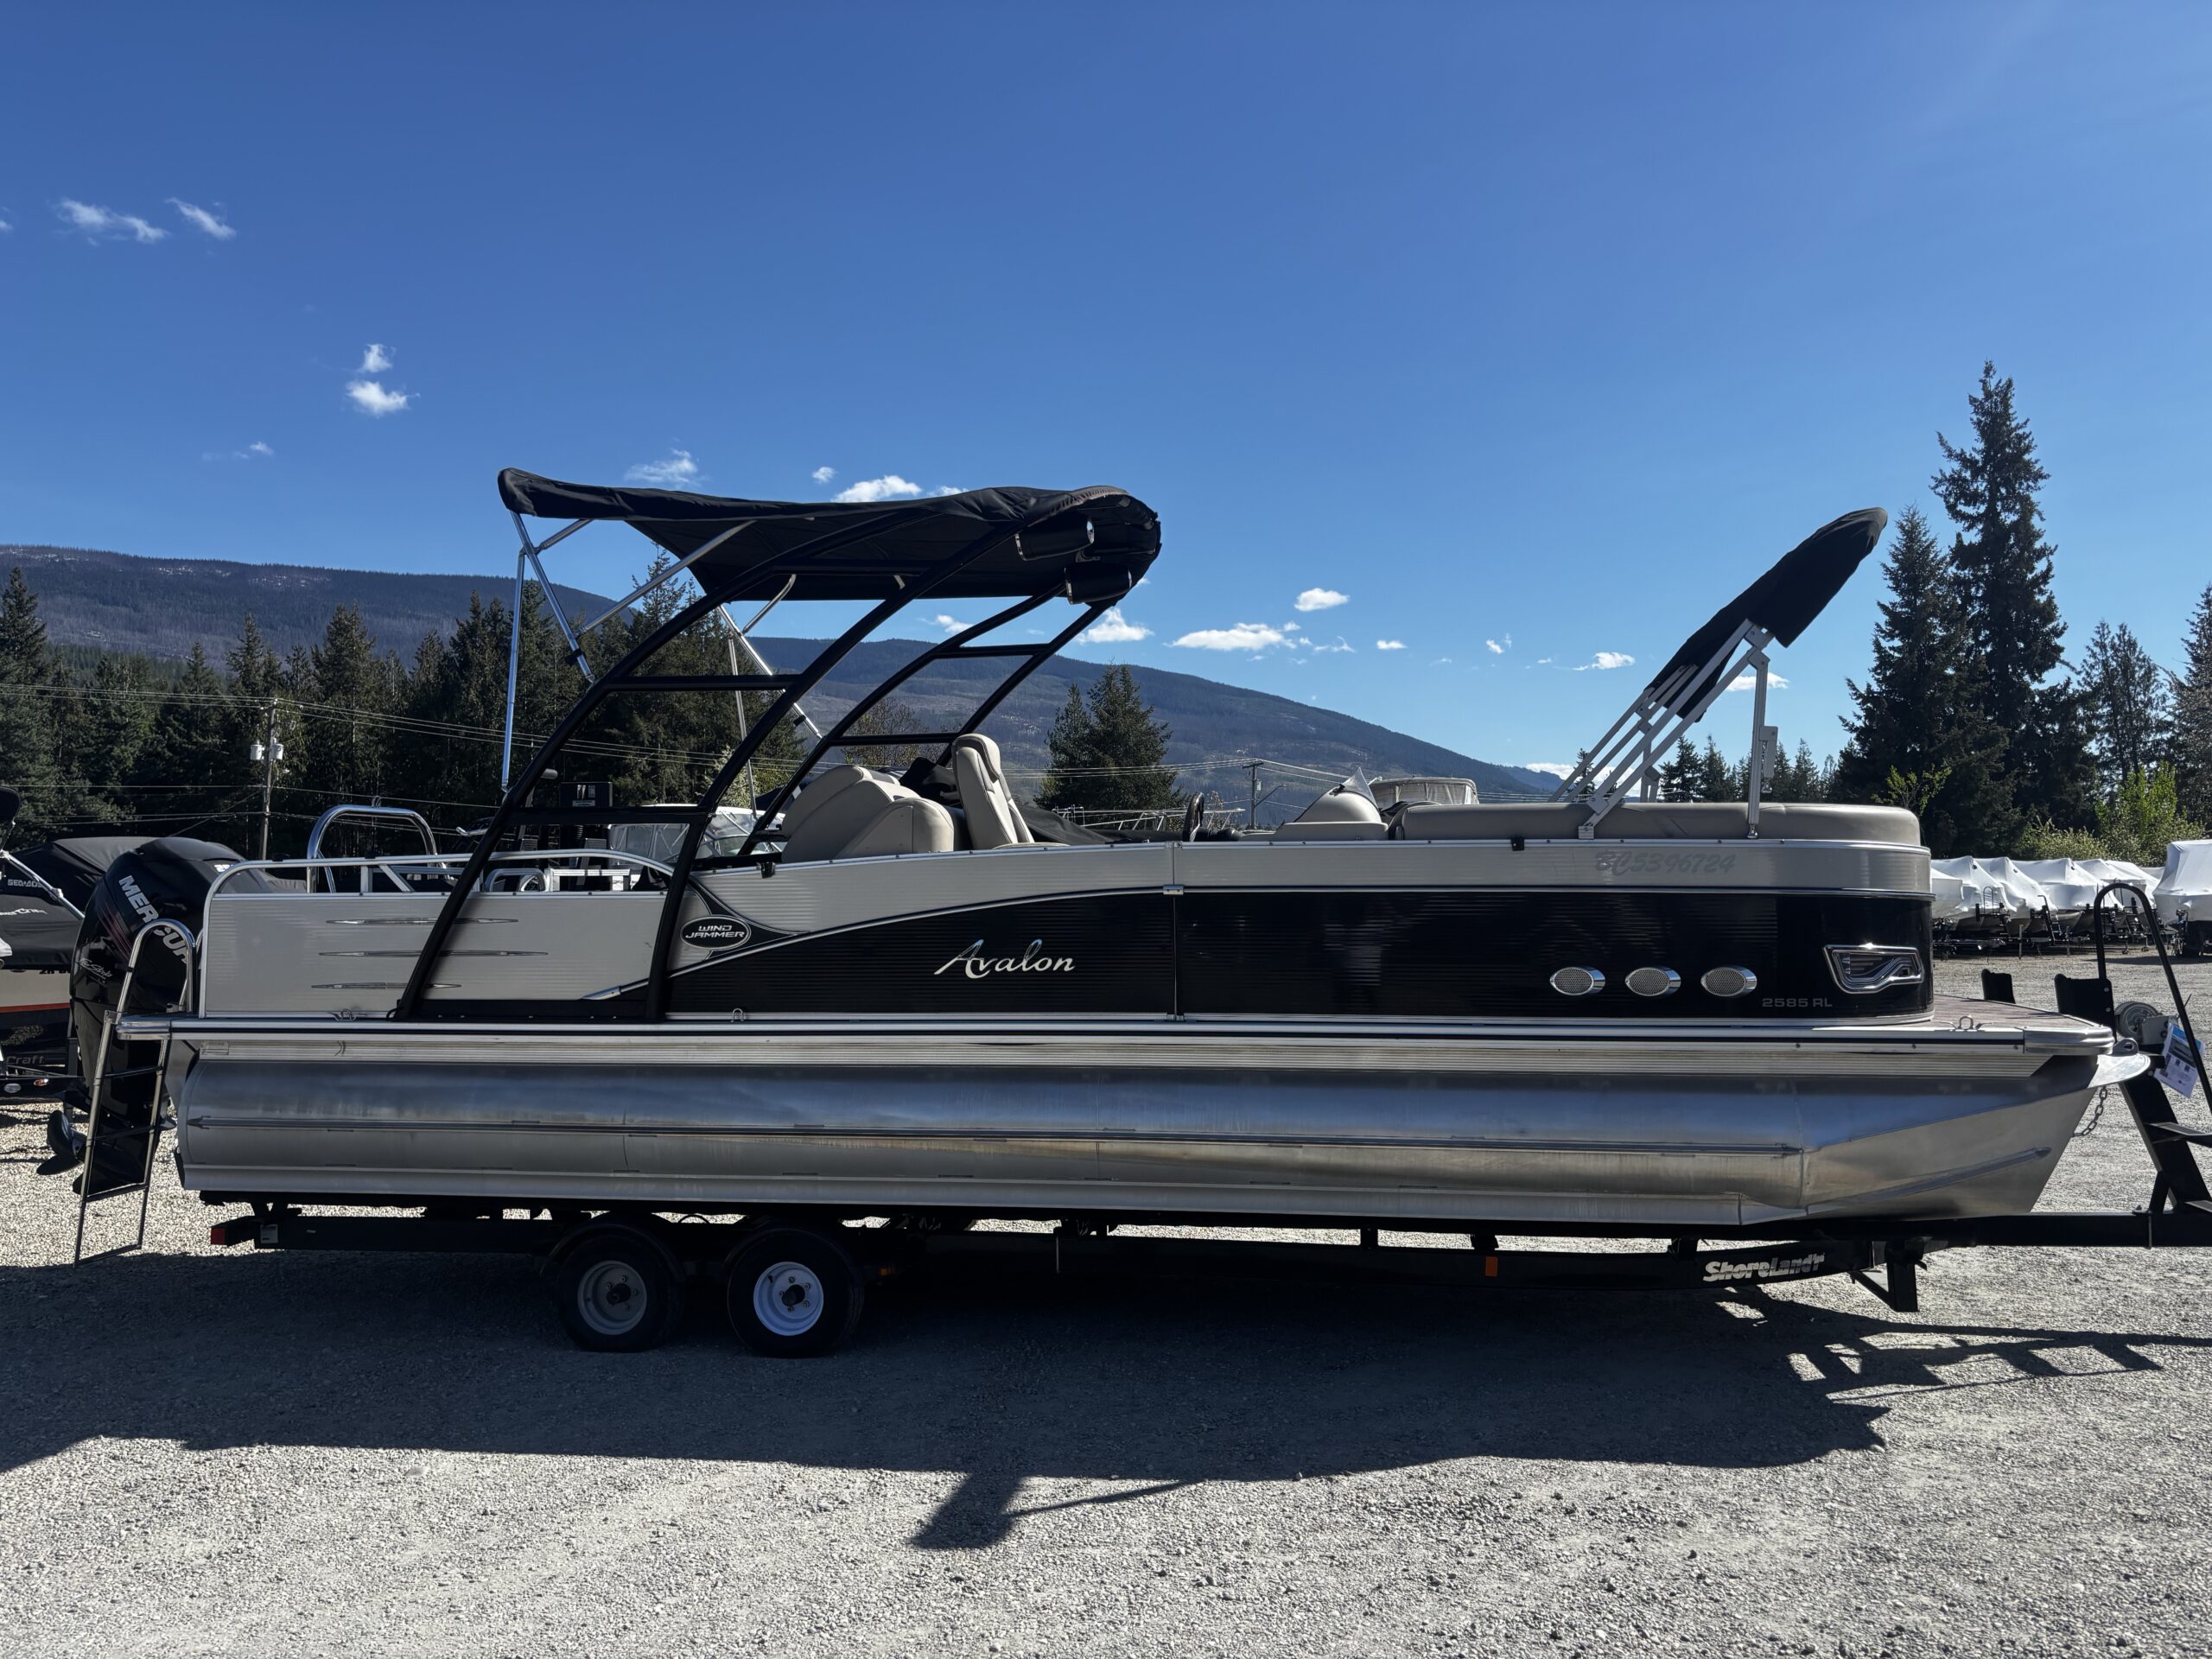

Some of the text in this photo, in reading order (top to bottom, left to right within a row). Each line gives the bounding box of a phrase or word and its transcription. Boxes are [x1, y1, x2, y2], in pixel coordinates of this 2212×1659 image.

[934, 939, 1076, 979] Avalon
[1762, 998, 1833, 1007] 2585 RL
